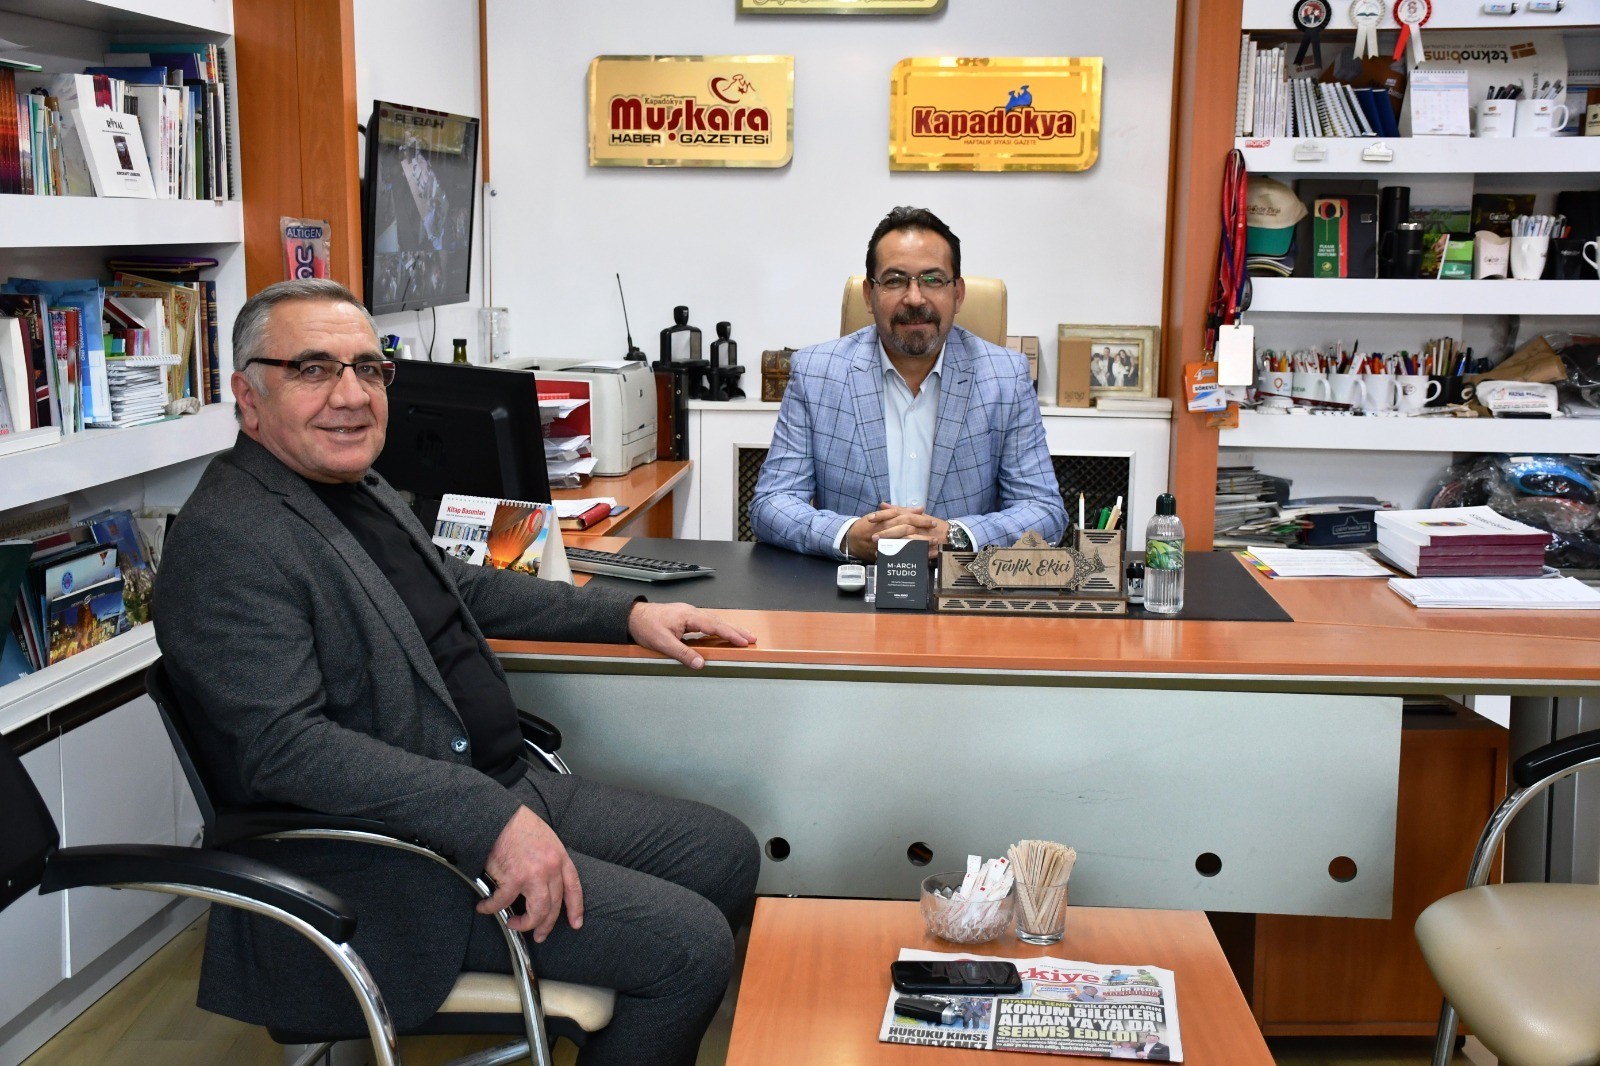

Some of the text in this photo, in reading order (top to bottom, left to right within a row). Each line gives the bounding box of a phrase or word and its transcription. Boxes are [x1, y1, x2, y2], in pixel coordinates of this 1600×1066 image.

[644, 98, 683, 106] Kapadokya
[914, 108, 1073, 137] Kapadokya
[611, 133, 661, 144] HABER
[286, 227, 322, 238] ALTIGEN
[446, 506, 461, 514] Kitap
[992, 558, 1071, 576] Tevfik Ekici
[887, 569, 917, 577] STUDIO
[999, 1003, 1070, 1016] KONUM
[998, 1014, 1125, 1031] ALMANYA'YA
[1128, 1020, 1157, 1032] DA
[889, 1027, 943, 1039] HUKUKU
